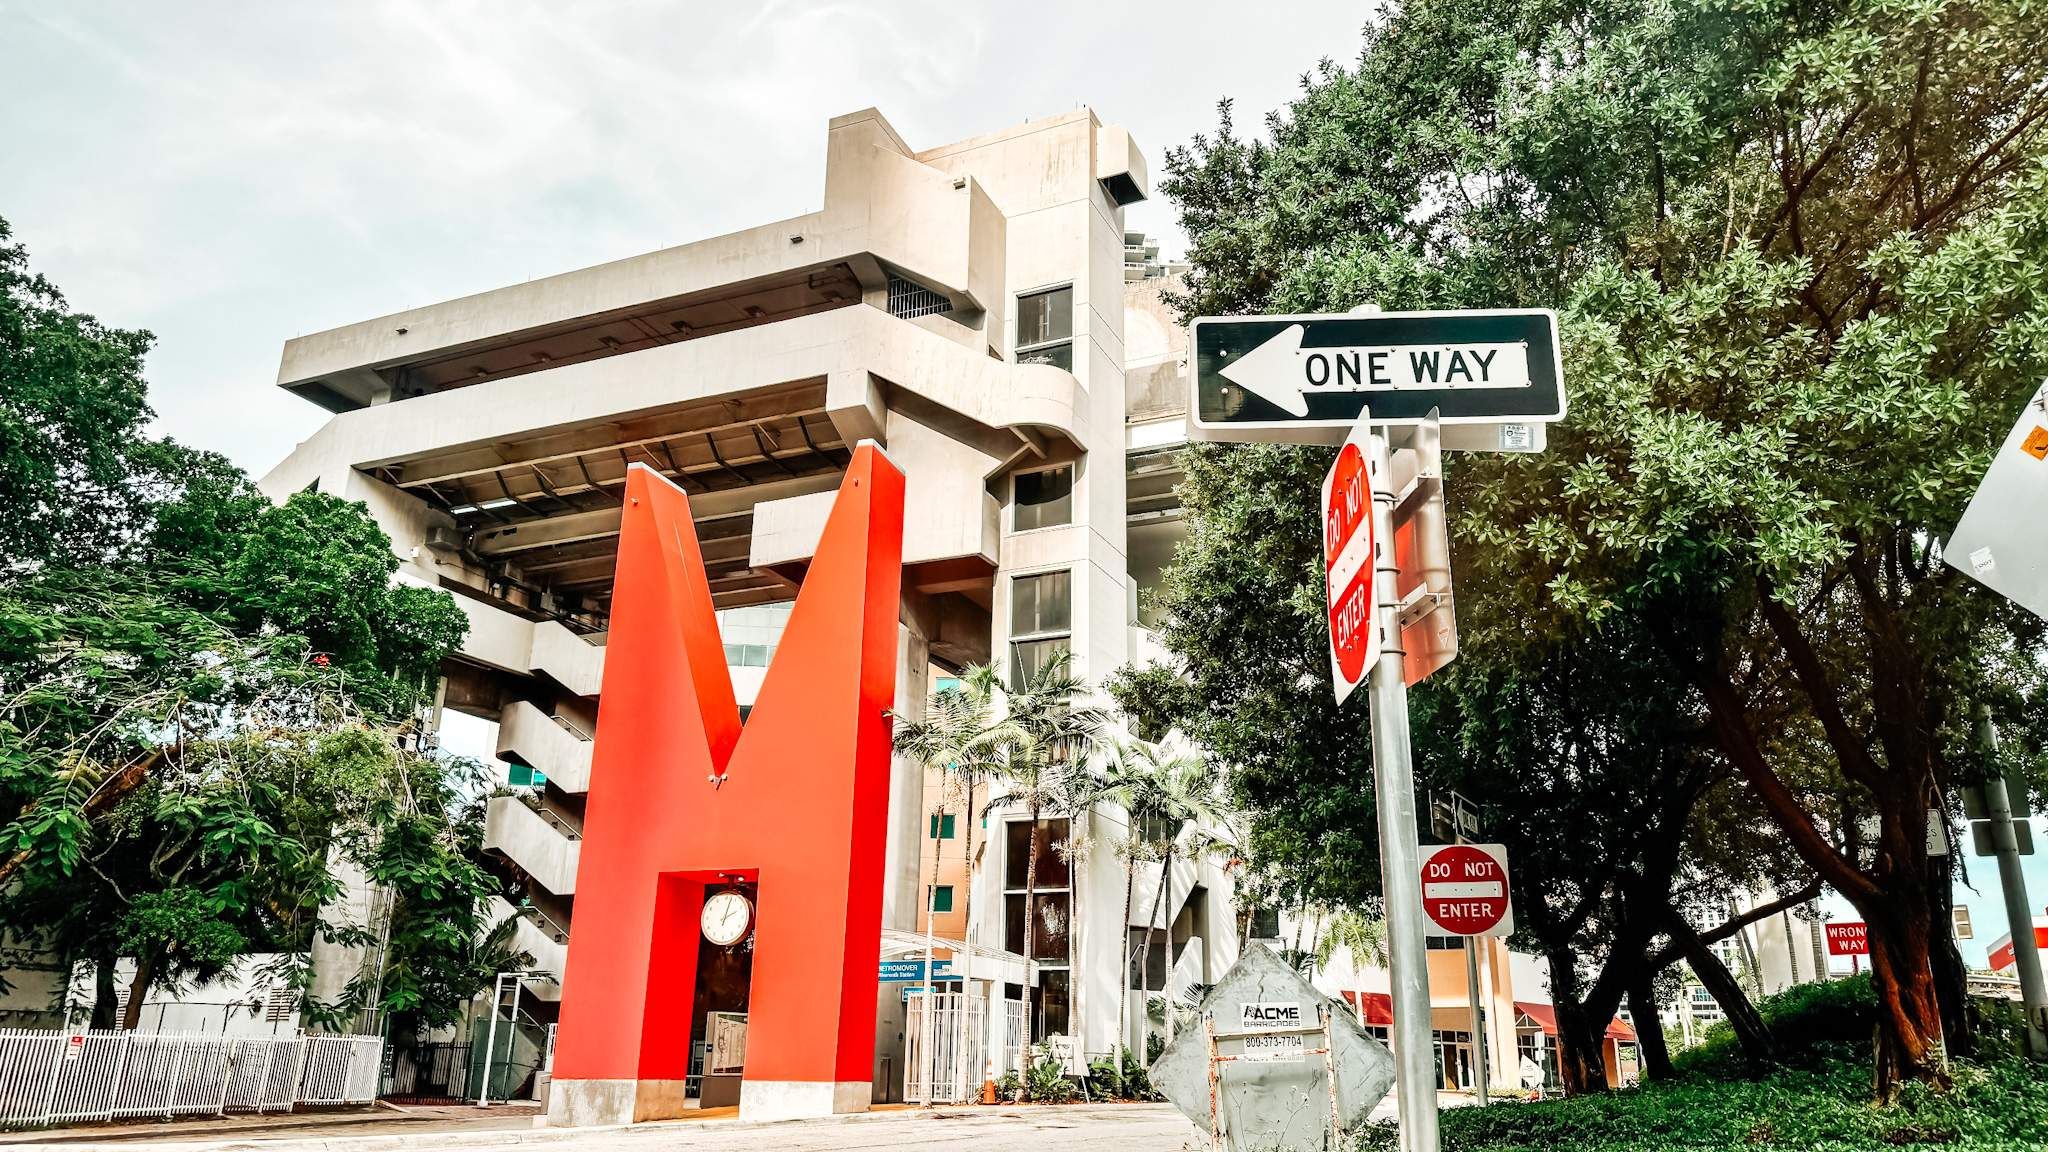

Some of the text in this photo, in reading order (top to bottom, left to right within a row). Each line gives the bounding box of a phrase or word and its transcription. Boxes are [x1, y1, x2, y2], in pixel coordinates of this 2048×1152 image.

[1305, 349, 1498, 387] ONE WAY
[1329, 466, 1364, 552] DO NOT
[1338, 583, 1366, 649] ENTER
[1430, 862, 1494, 878] DO NOT
[1439, 903, 1495, 918] ENTER
[1828, 926, 1868, 938] WRON
[1839, 939, 1866, 951] WAY
[1254, 1007, 1299, 1020] ACME
[1243, 1020, 1301, 1028] BARRICADES
[1245, 1036, 1302, 1048] 800-373-7704
